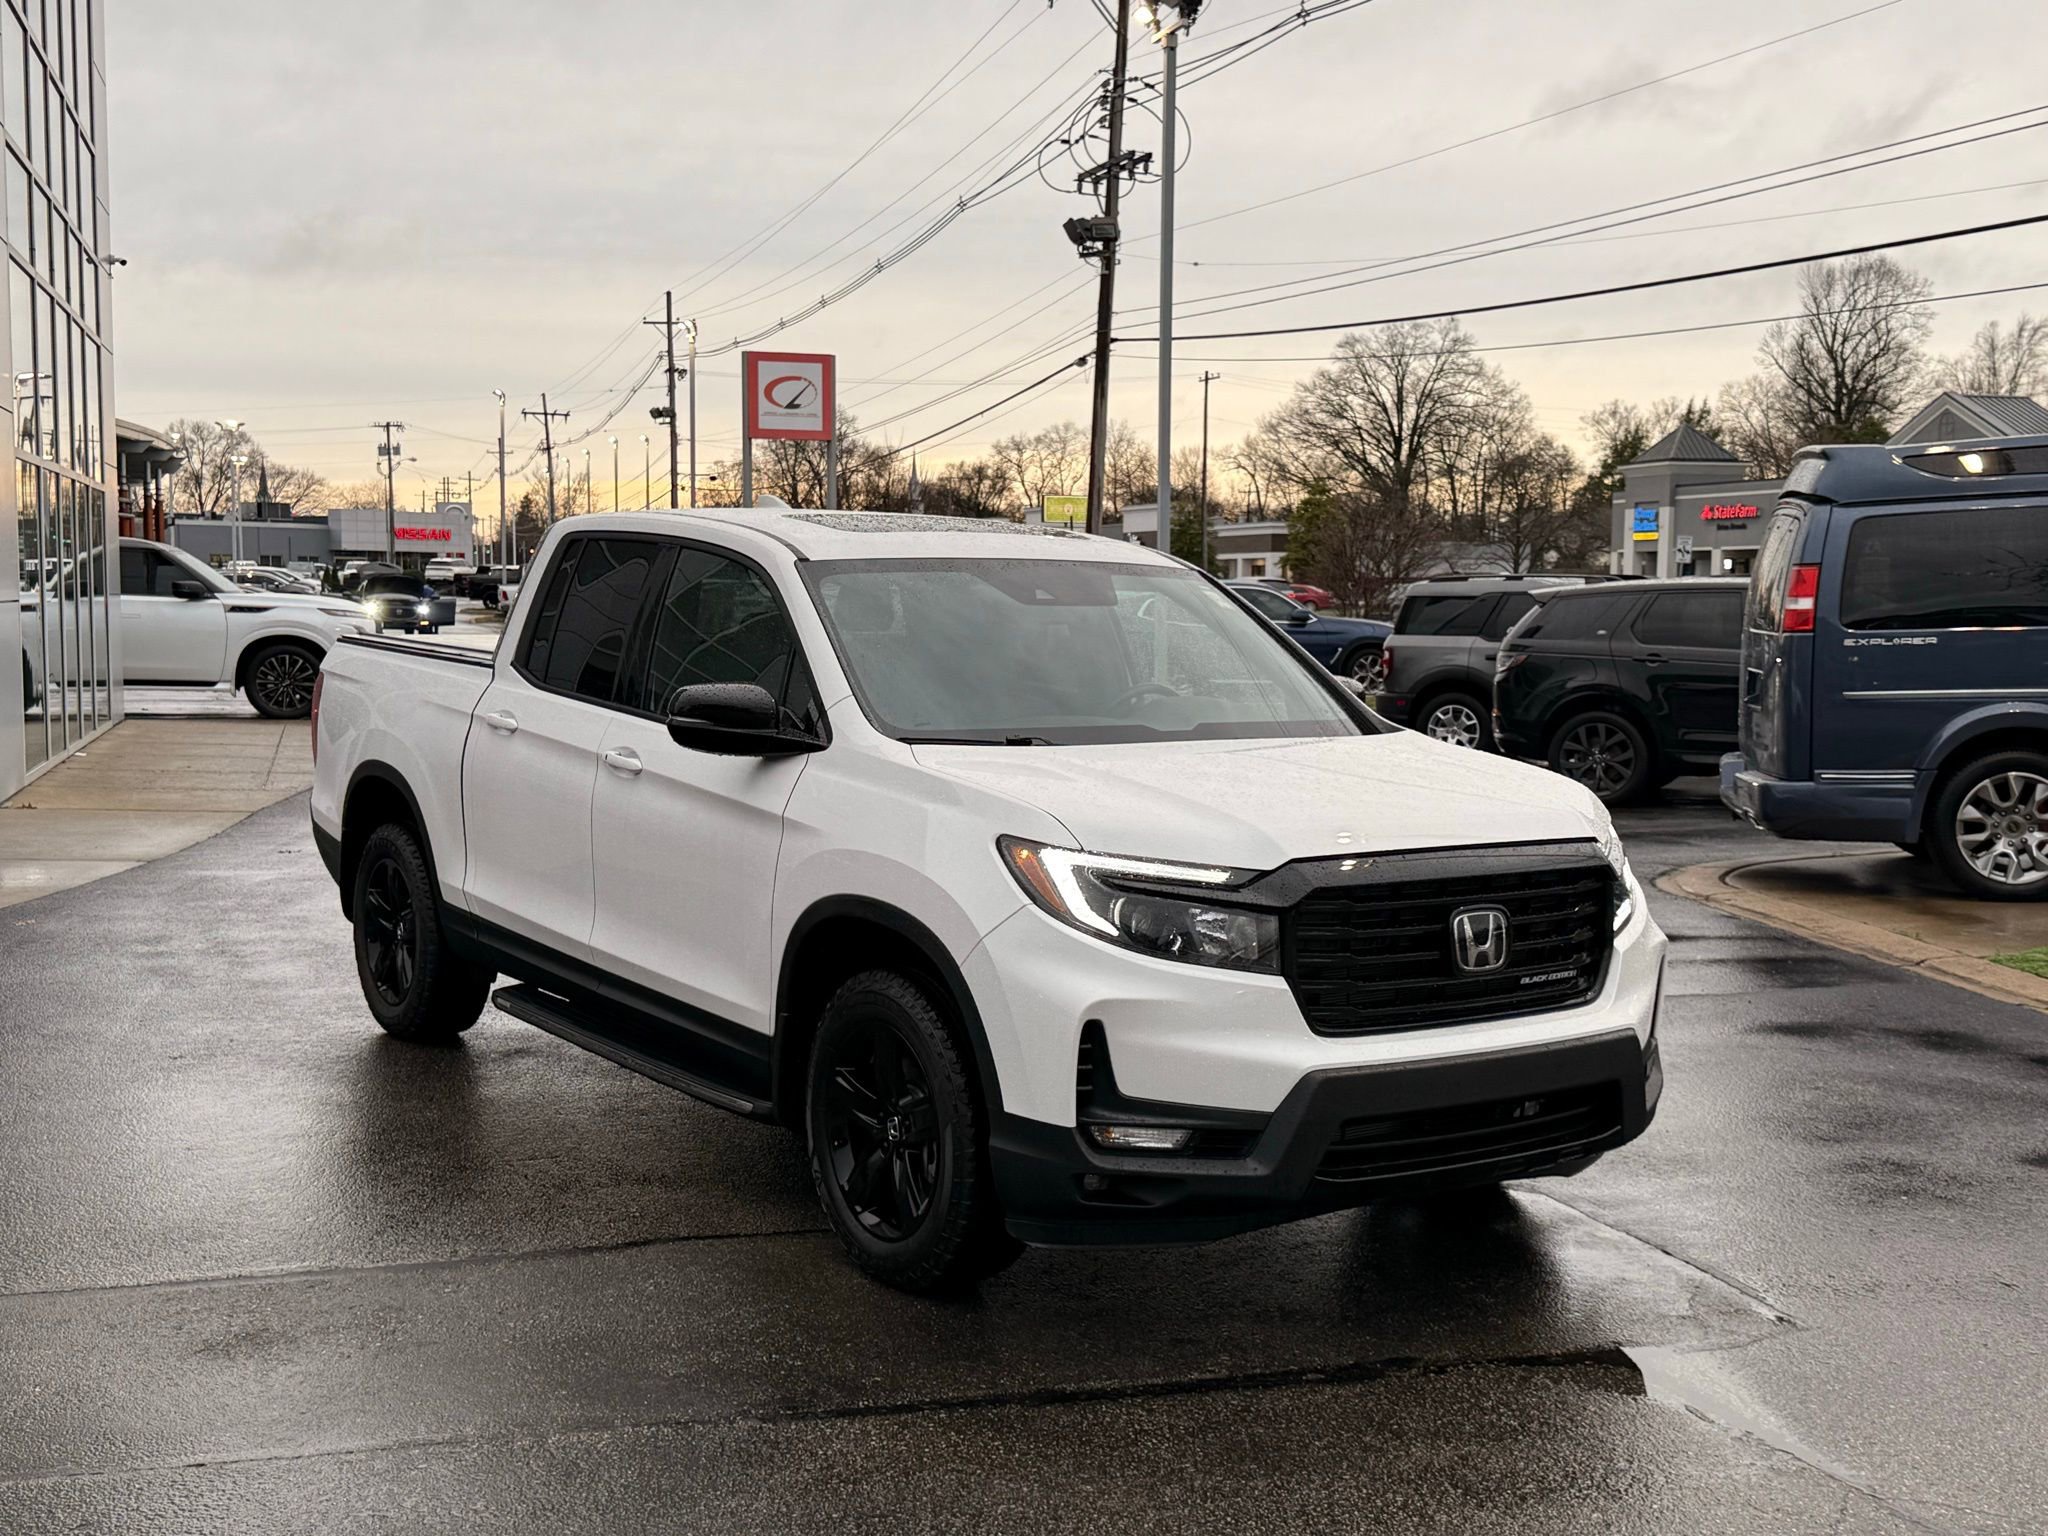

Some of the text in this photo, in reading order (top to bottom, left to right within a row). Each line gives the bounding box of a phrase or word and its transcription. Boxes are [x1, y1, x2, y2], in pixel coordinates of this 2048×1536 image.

[393, 527, 452, 542] NISSAN
[1843, 637, 1938, 646] EXPLORER
[1520, 974, 1548, 985] BLACK
